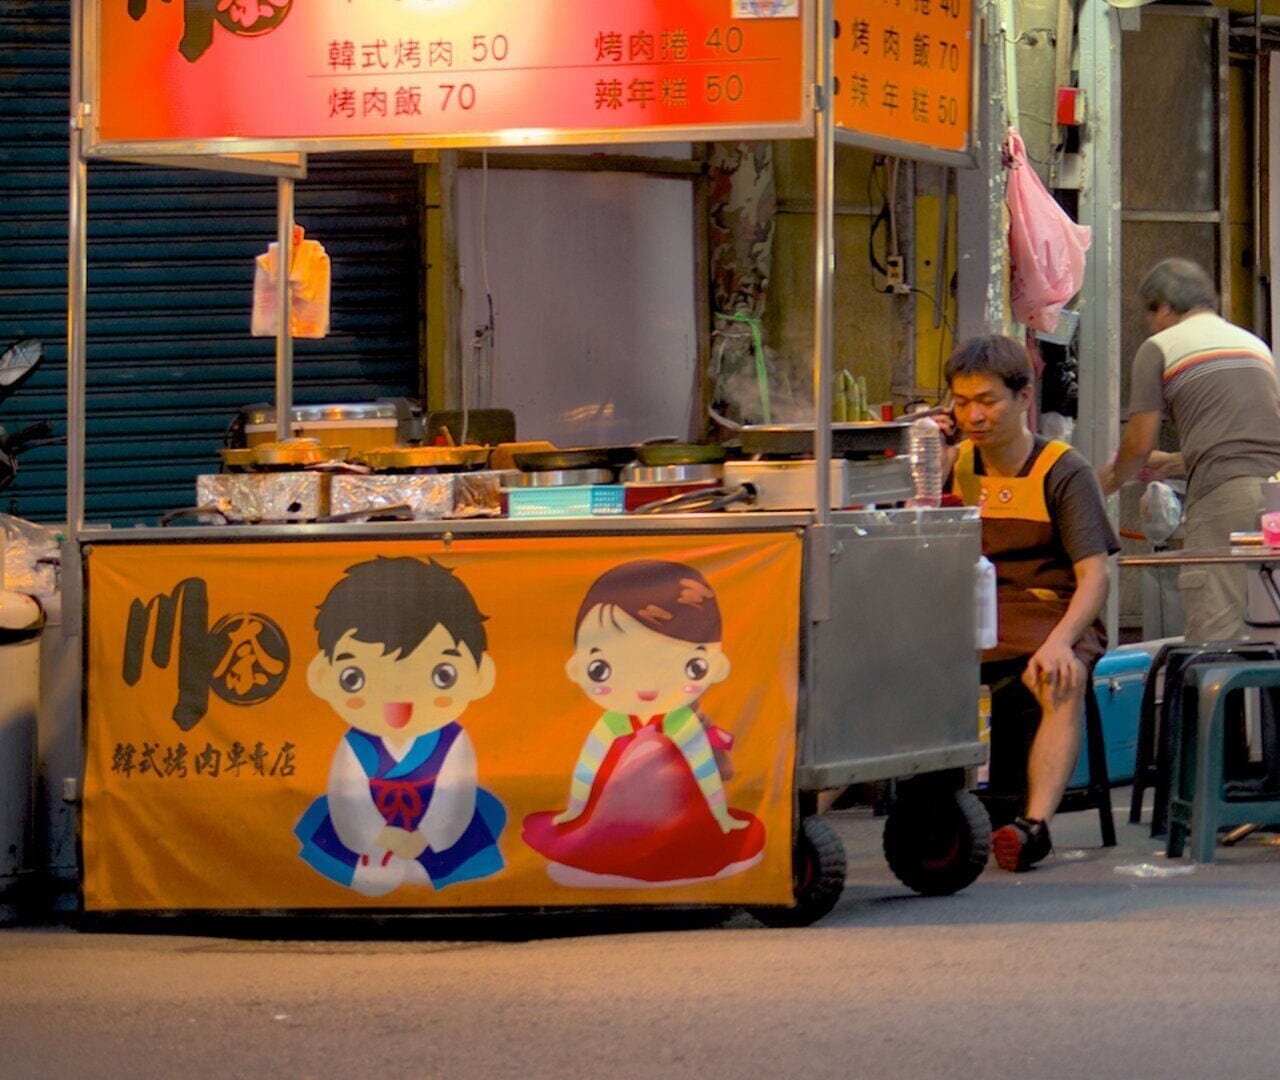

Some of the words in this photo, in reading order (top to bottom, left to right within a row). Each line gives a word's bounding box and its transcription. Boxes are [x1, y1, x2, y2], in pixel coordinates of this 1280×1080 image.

[327, 37, 454, 72] 韓式烤肉
[471, 34, 509, 63] 50
[595, 29, 689, 63] 烤肉捲
[705, 26, 743, 54] 40
[851, 18, 931, 69] 烤肉飯
[938, 42, 960, 73] 70
[327, 85, 422, 119] 烤肉飯
[439, 83, 477, 111] 70
[595, 78, 689, 111] 辣年糕
[705, 74, 743, 103] 50
[850, 73, 930, 123] 辣年糕
[937, 96, 958, 126] 50
[111, 740, 298, 779] 韓式烤肉專賣店
